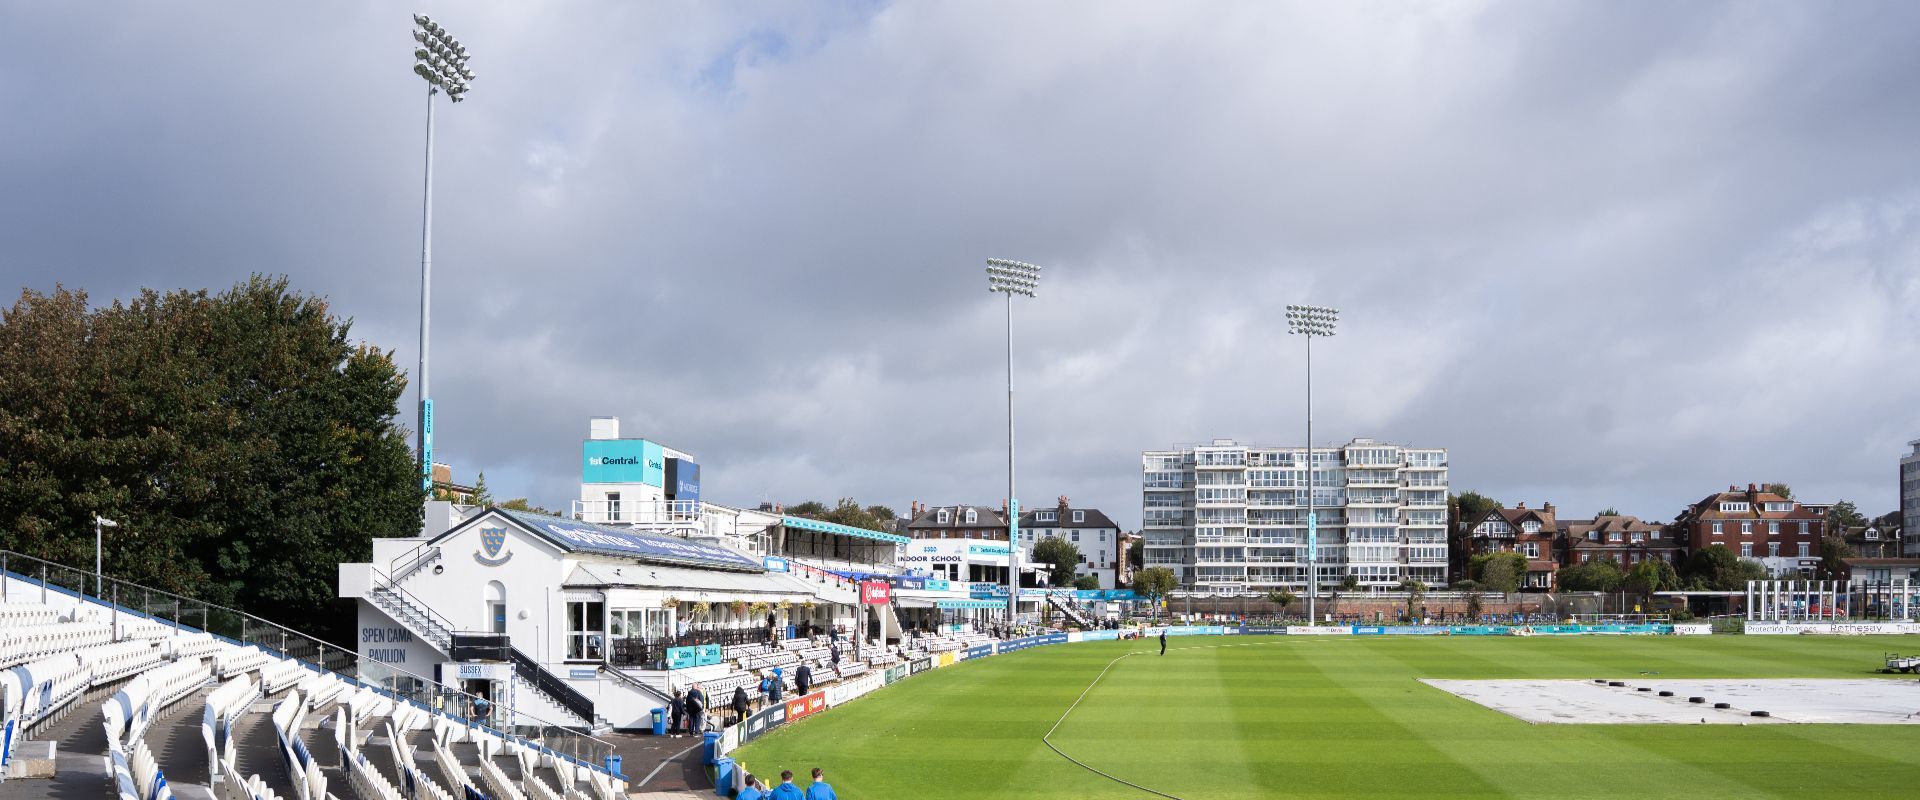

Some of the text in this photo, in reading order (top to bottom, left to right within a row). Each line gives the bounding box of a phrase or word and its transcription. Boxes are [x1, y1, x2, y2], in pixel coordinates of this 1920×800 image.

[1830, 624, 1883, 634] Rothesay
[362, 628, 413, 643] SPEN CAMA
[368, 648, 406, 663] PAVILION
[460, 665, 482, 674] SUSSEX
